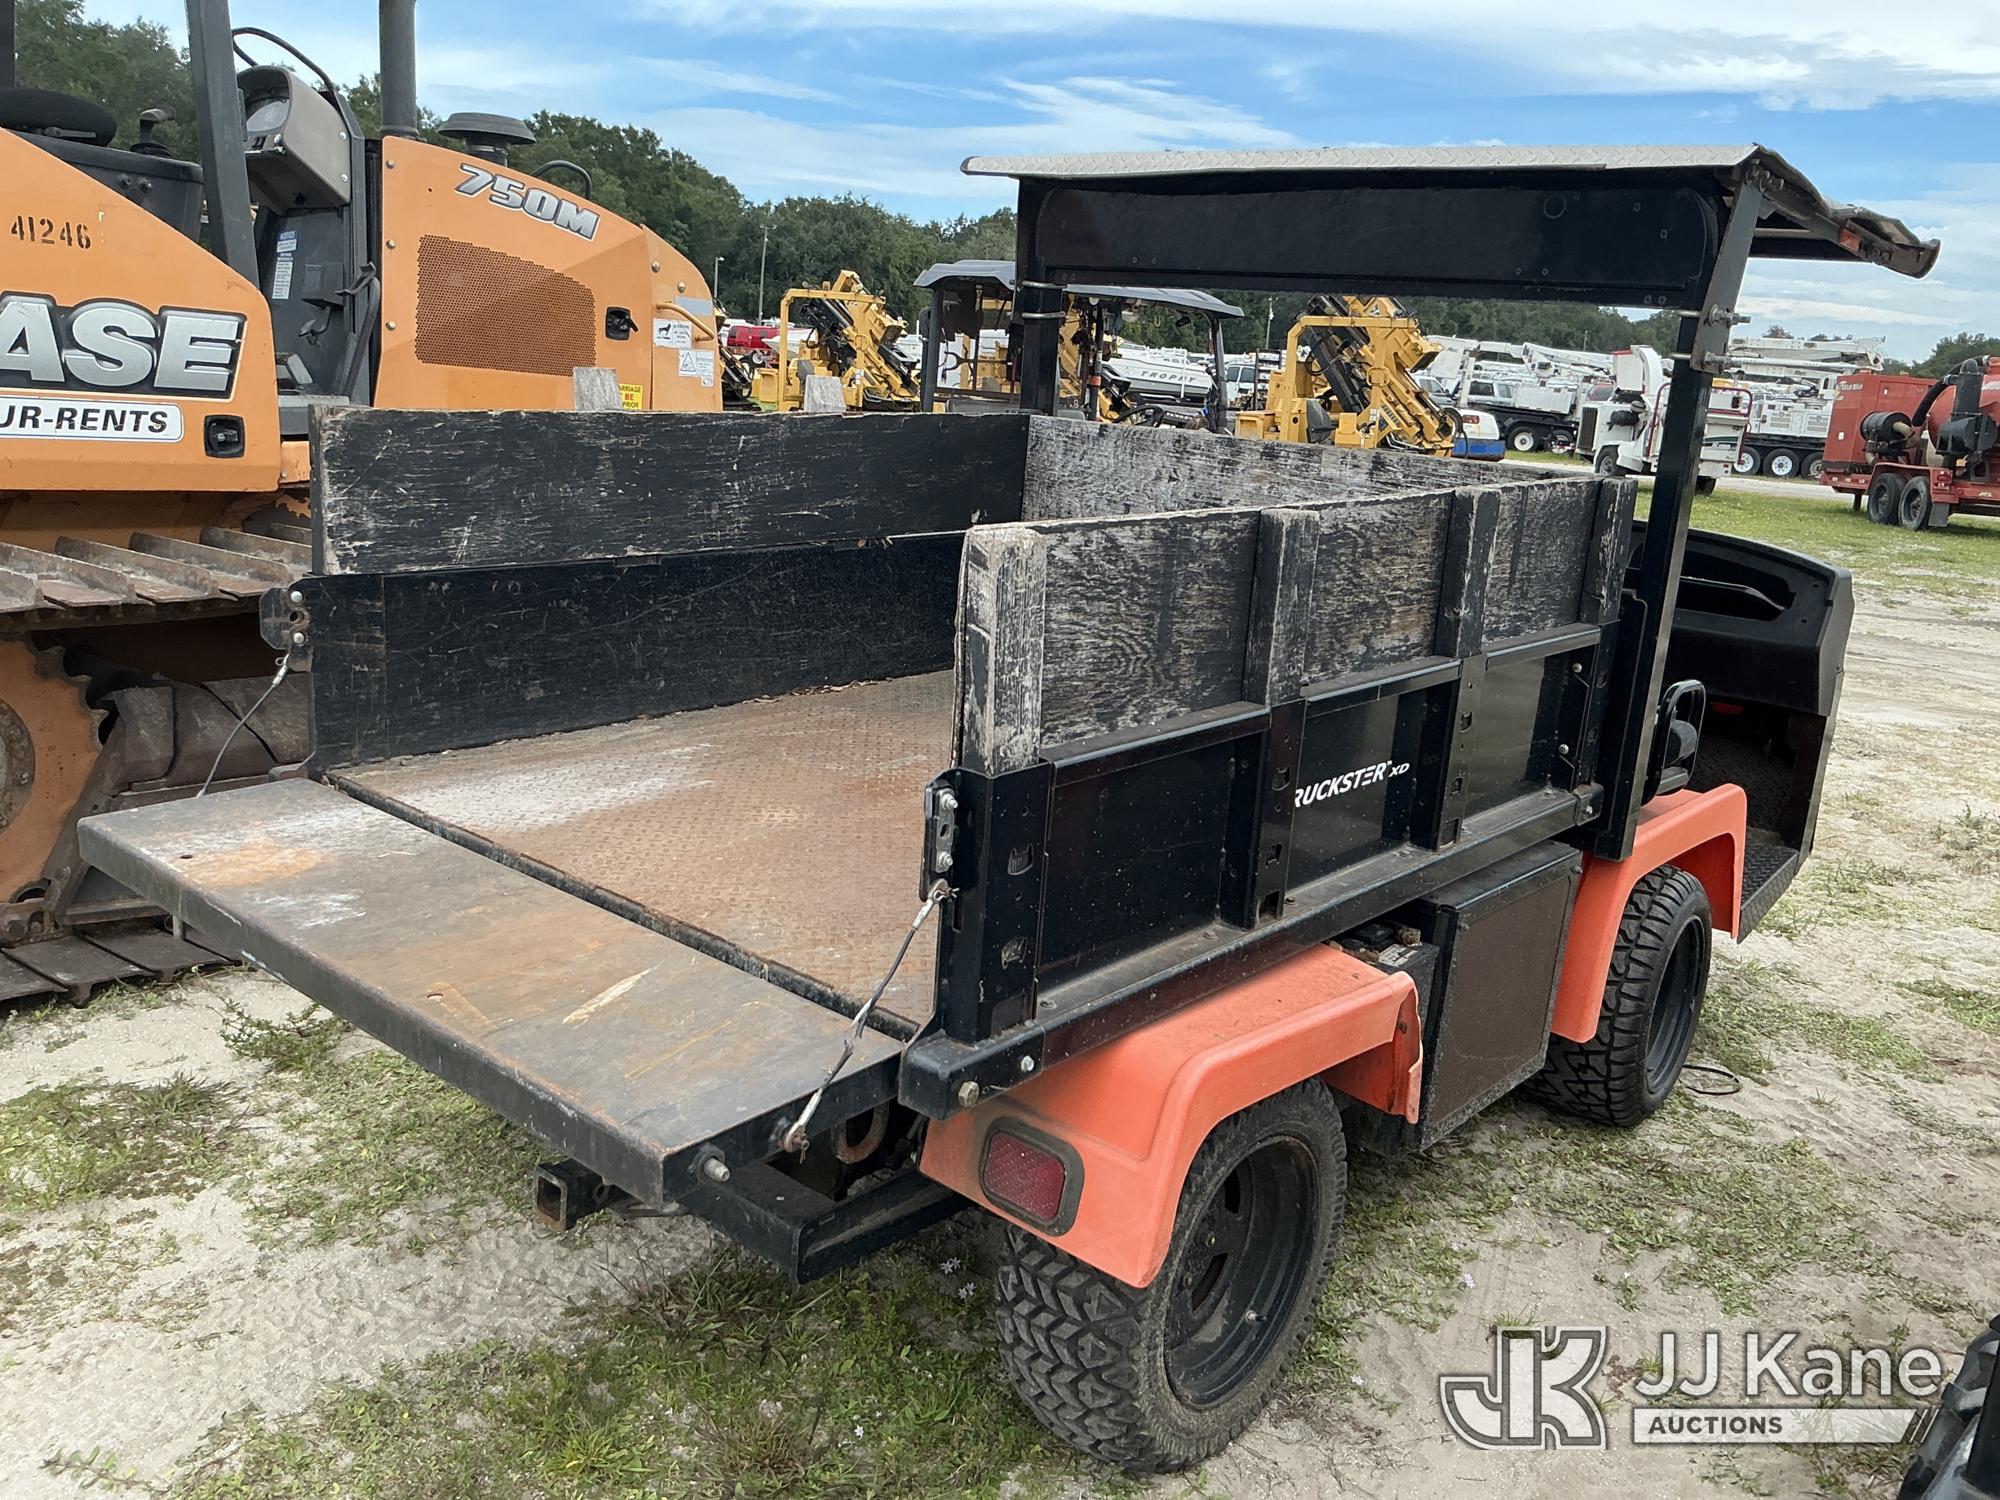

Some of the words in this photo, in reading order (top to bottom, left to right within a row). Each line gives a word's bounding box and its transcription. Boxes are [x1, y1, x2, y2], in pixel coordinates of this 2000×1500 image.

[455, 163, 600, 241] 750M
[11, 215, 92, 250] 41246
[624, 393, 635, 401] BE
